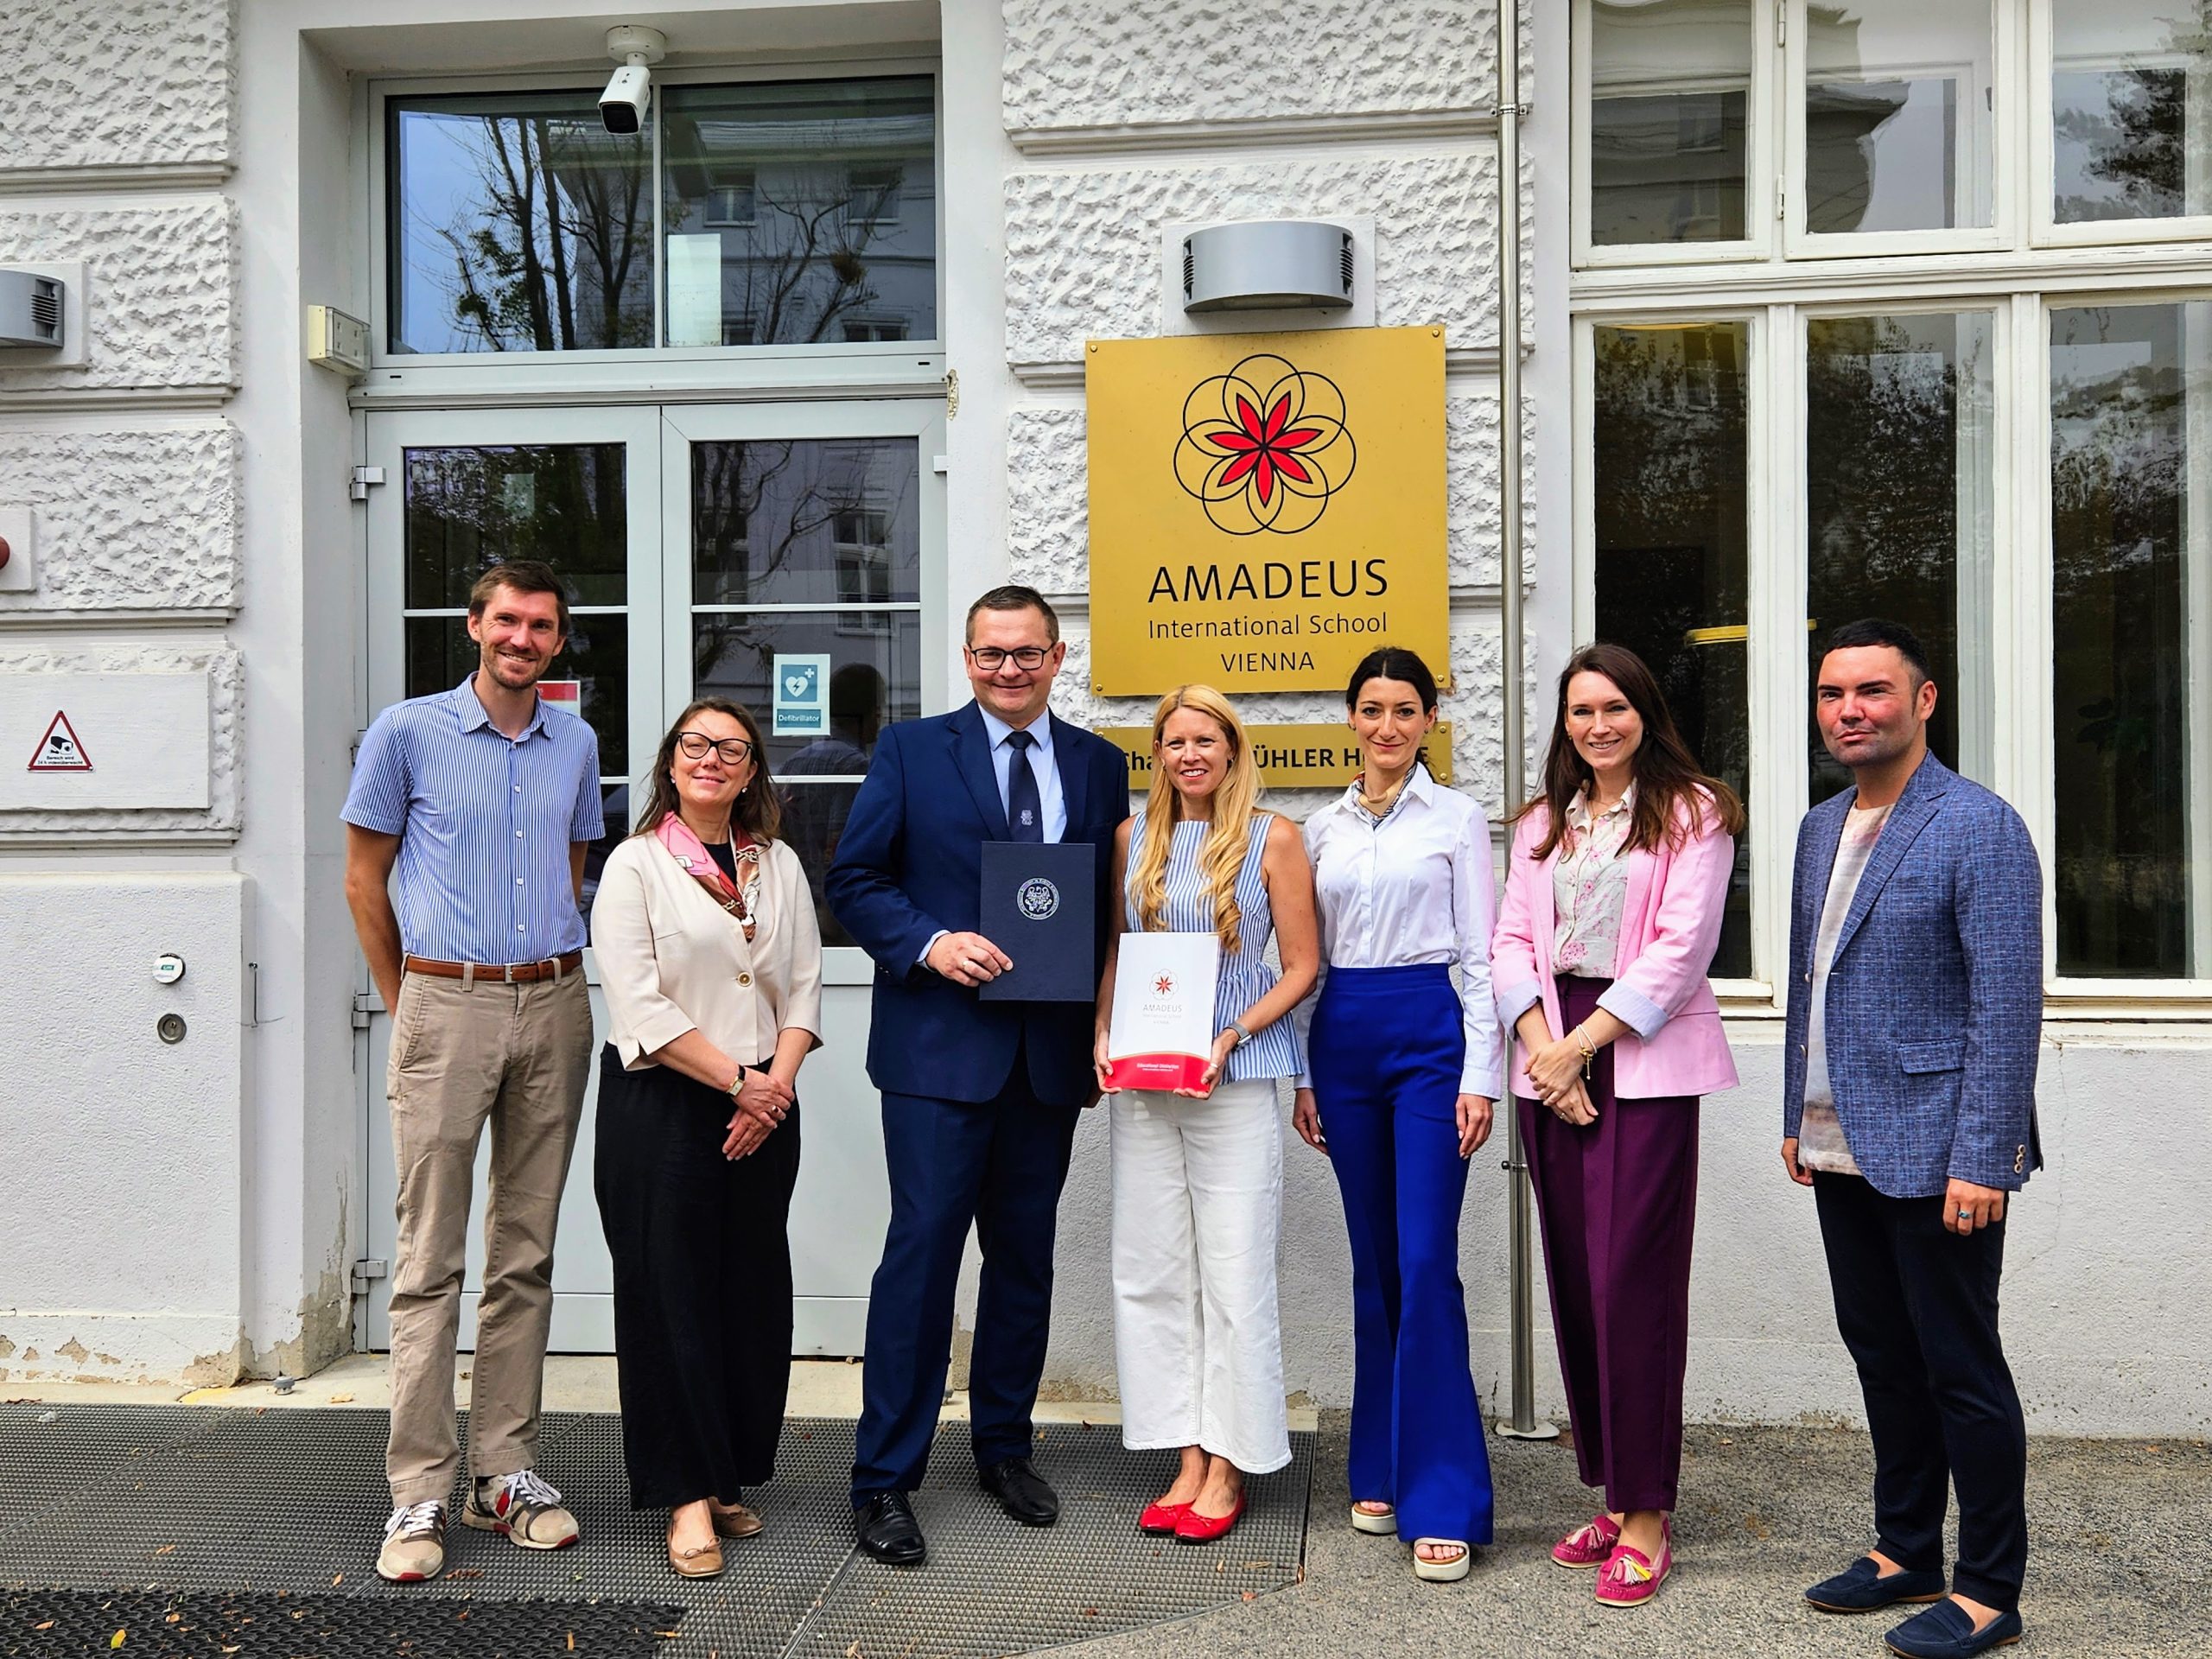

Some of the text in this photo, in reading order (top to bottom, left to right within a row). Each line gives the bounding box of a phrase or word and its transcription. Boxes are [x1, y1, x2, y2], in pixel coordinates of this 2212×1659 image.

[1147, 559, 1388, 603] AMADEUS
[1149, 612, 1387, 639] International School
[1221, 652, 1315, 673] VIENNA
[1253, 744, 1335, 768] ÜHLER
